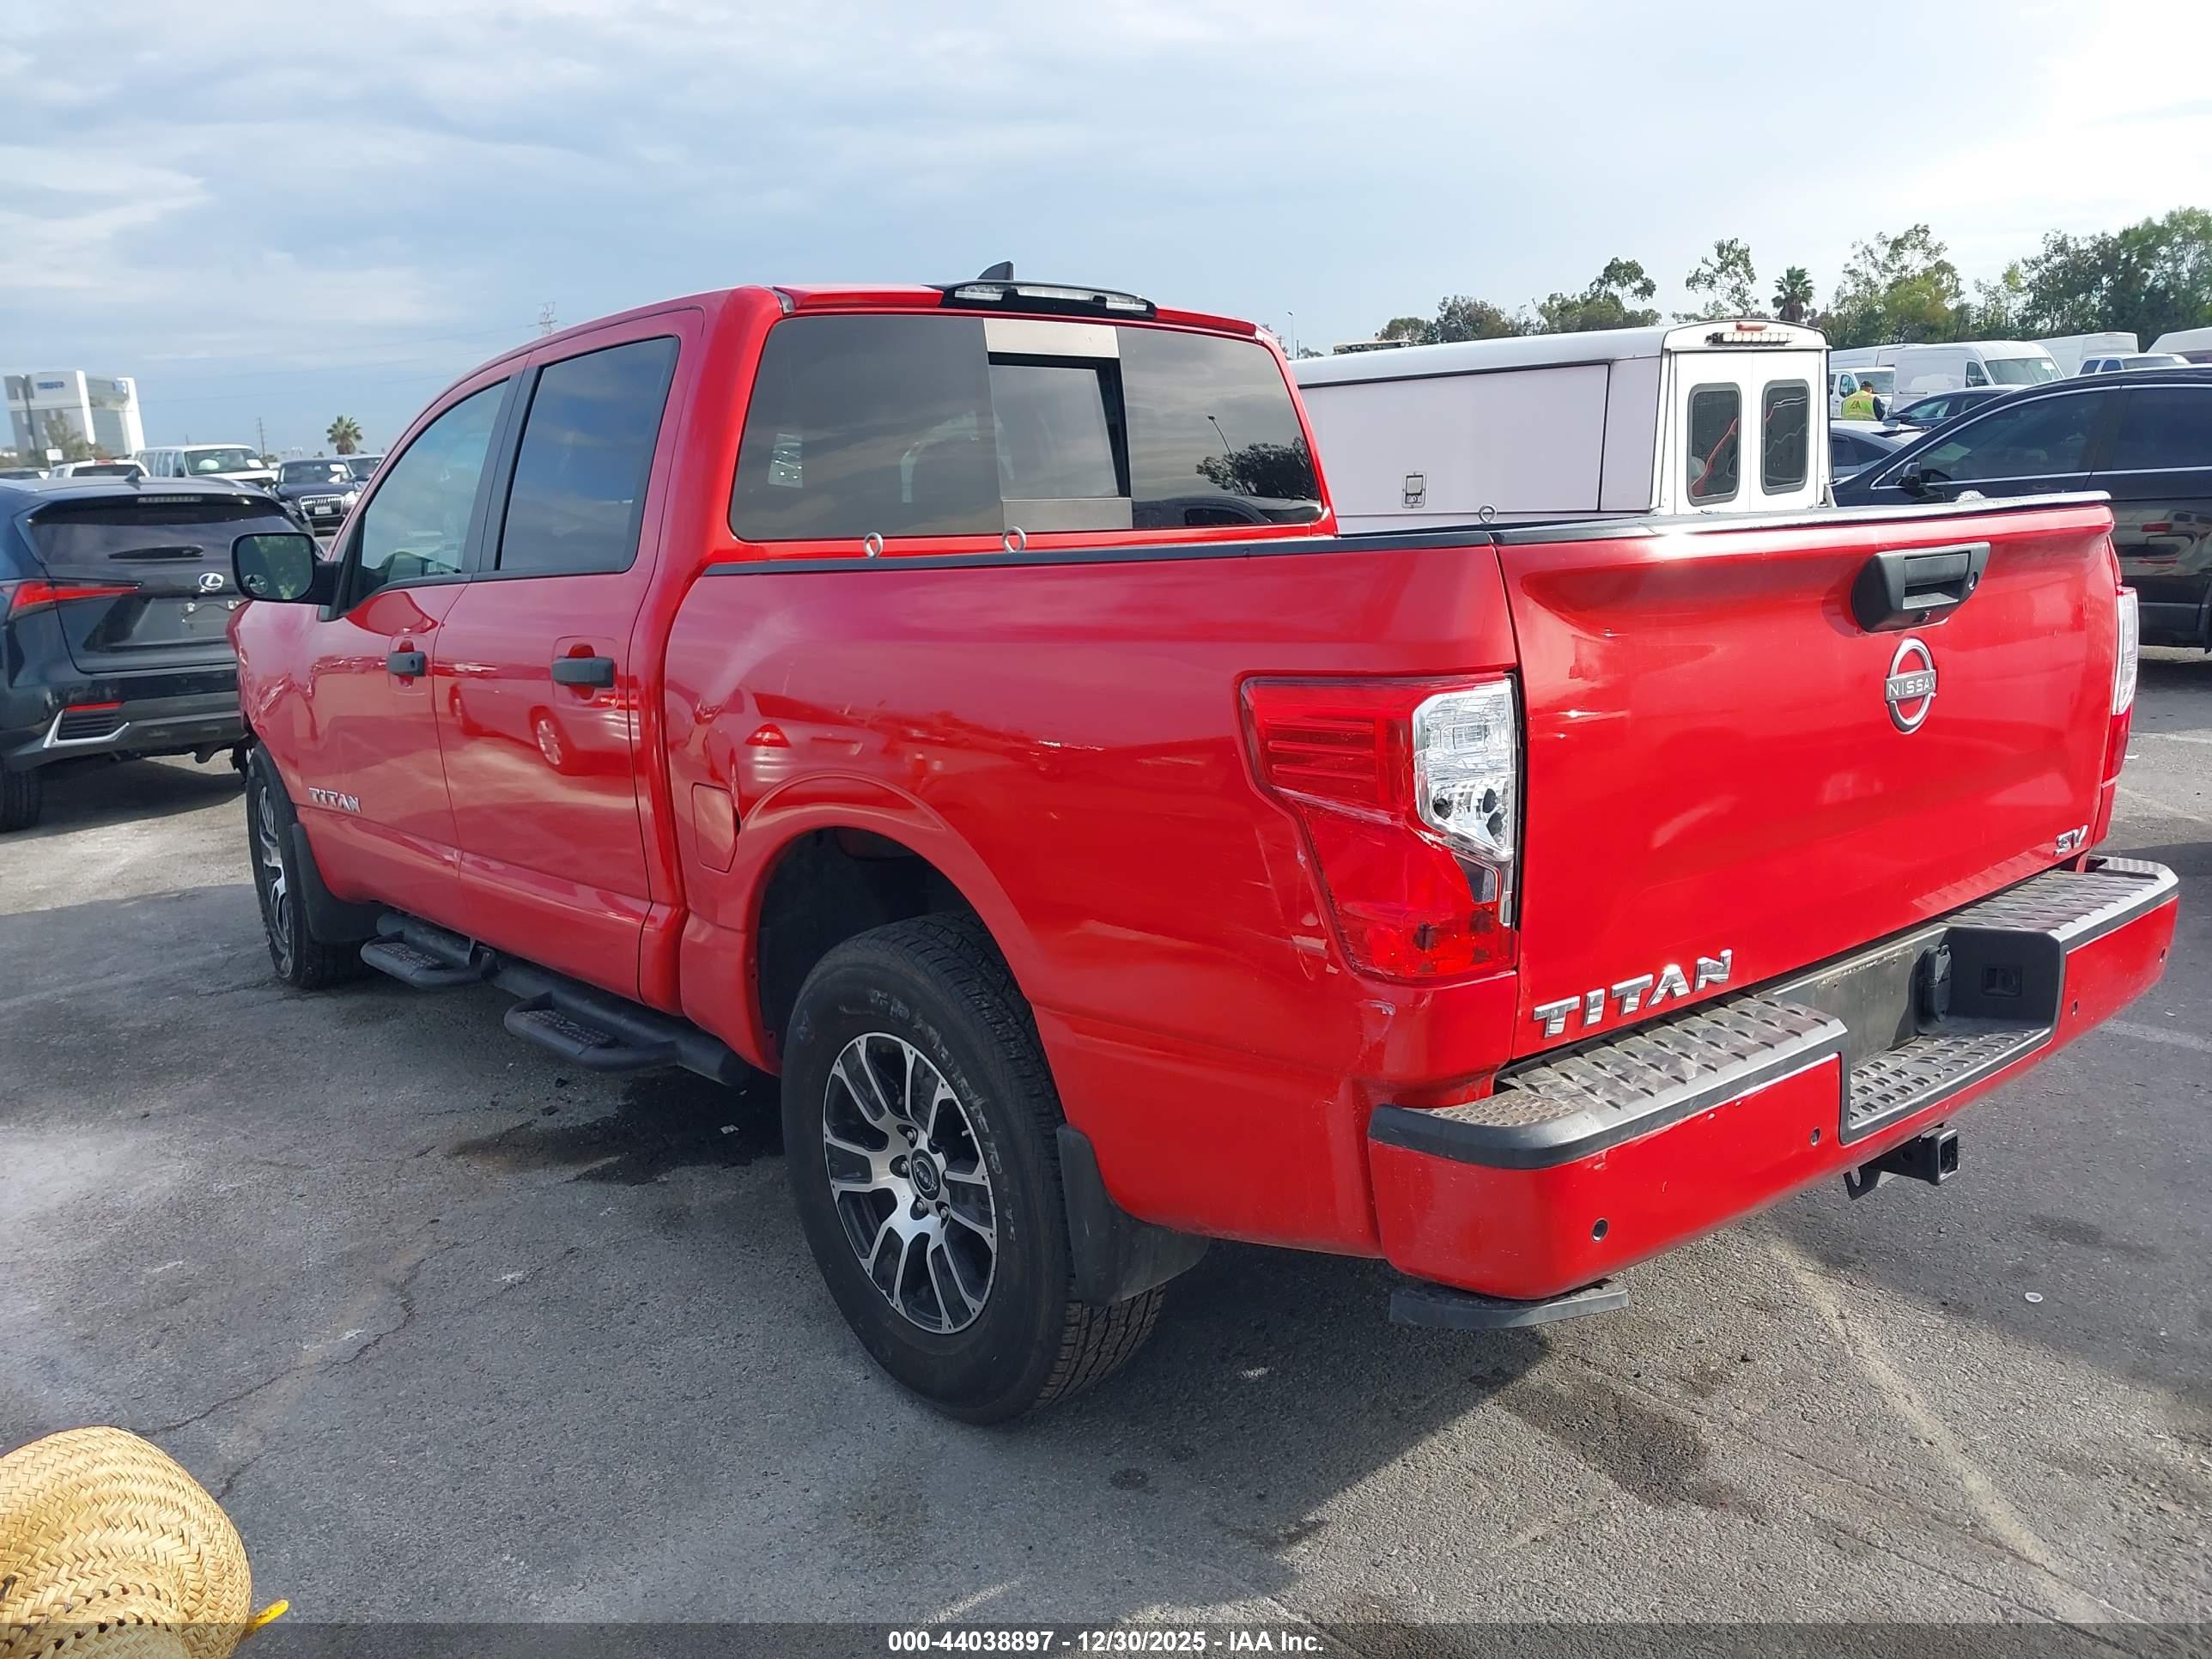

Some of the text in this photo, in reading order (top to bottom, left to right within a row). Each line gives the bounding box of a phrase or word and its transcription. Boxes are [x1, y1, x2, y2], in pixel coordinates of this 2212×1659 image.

[1888, 676, 1936, 696] NISSAN
[309, 787, 361, 813] TITAN
[2054, 824, 2088, 854] SV
[1534, 949, 1732, 1038] TITAN
